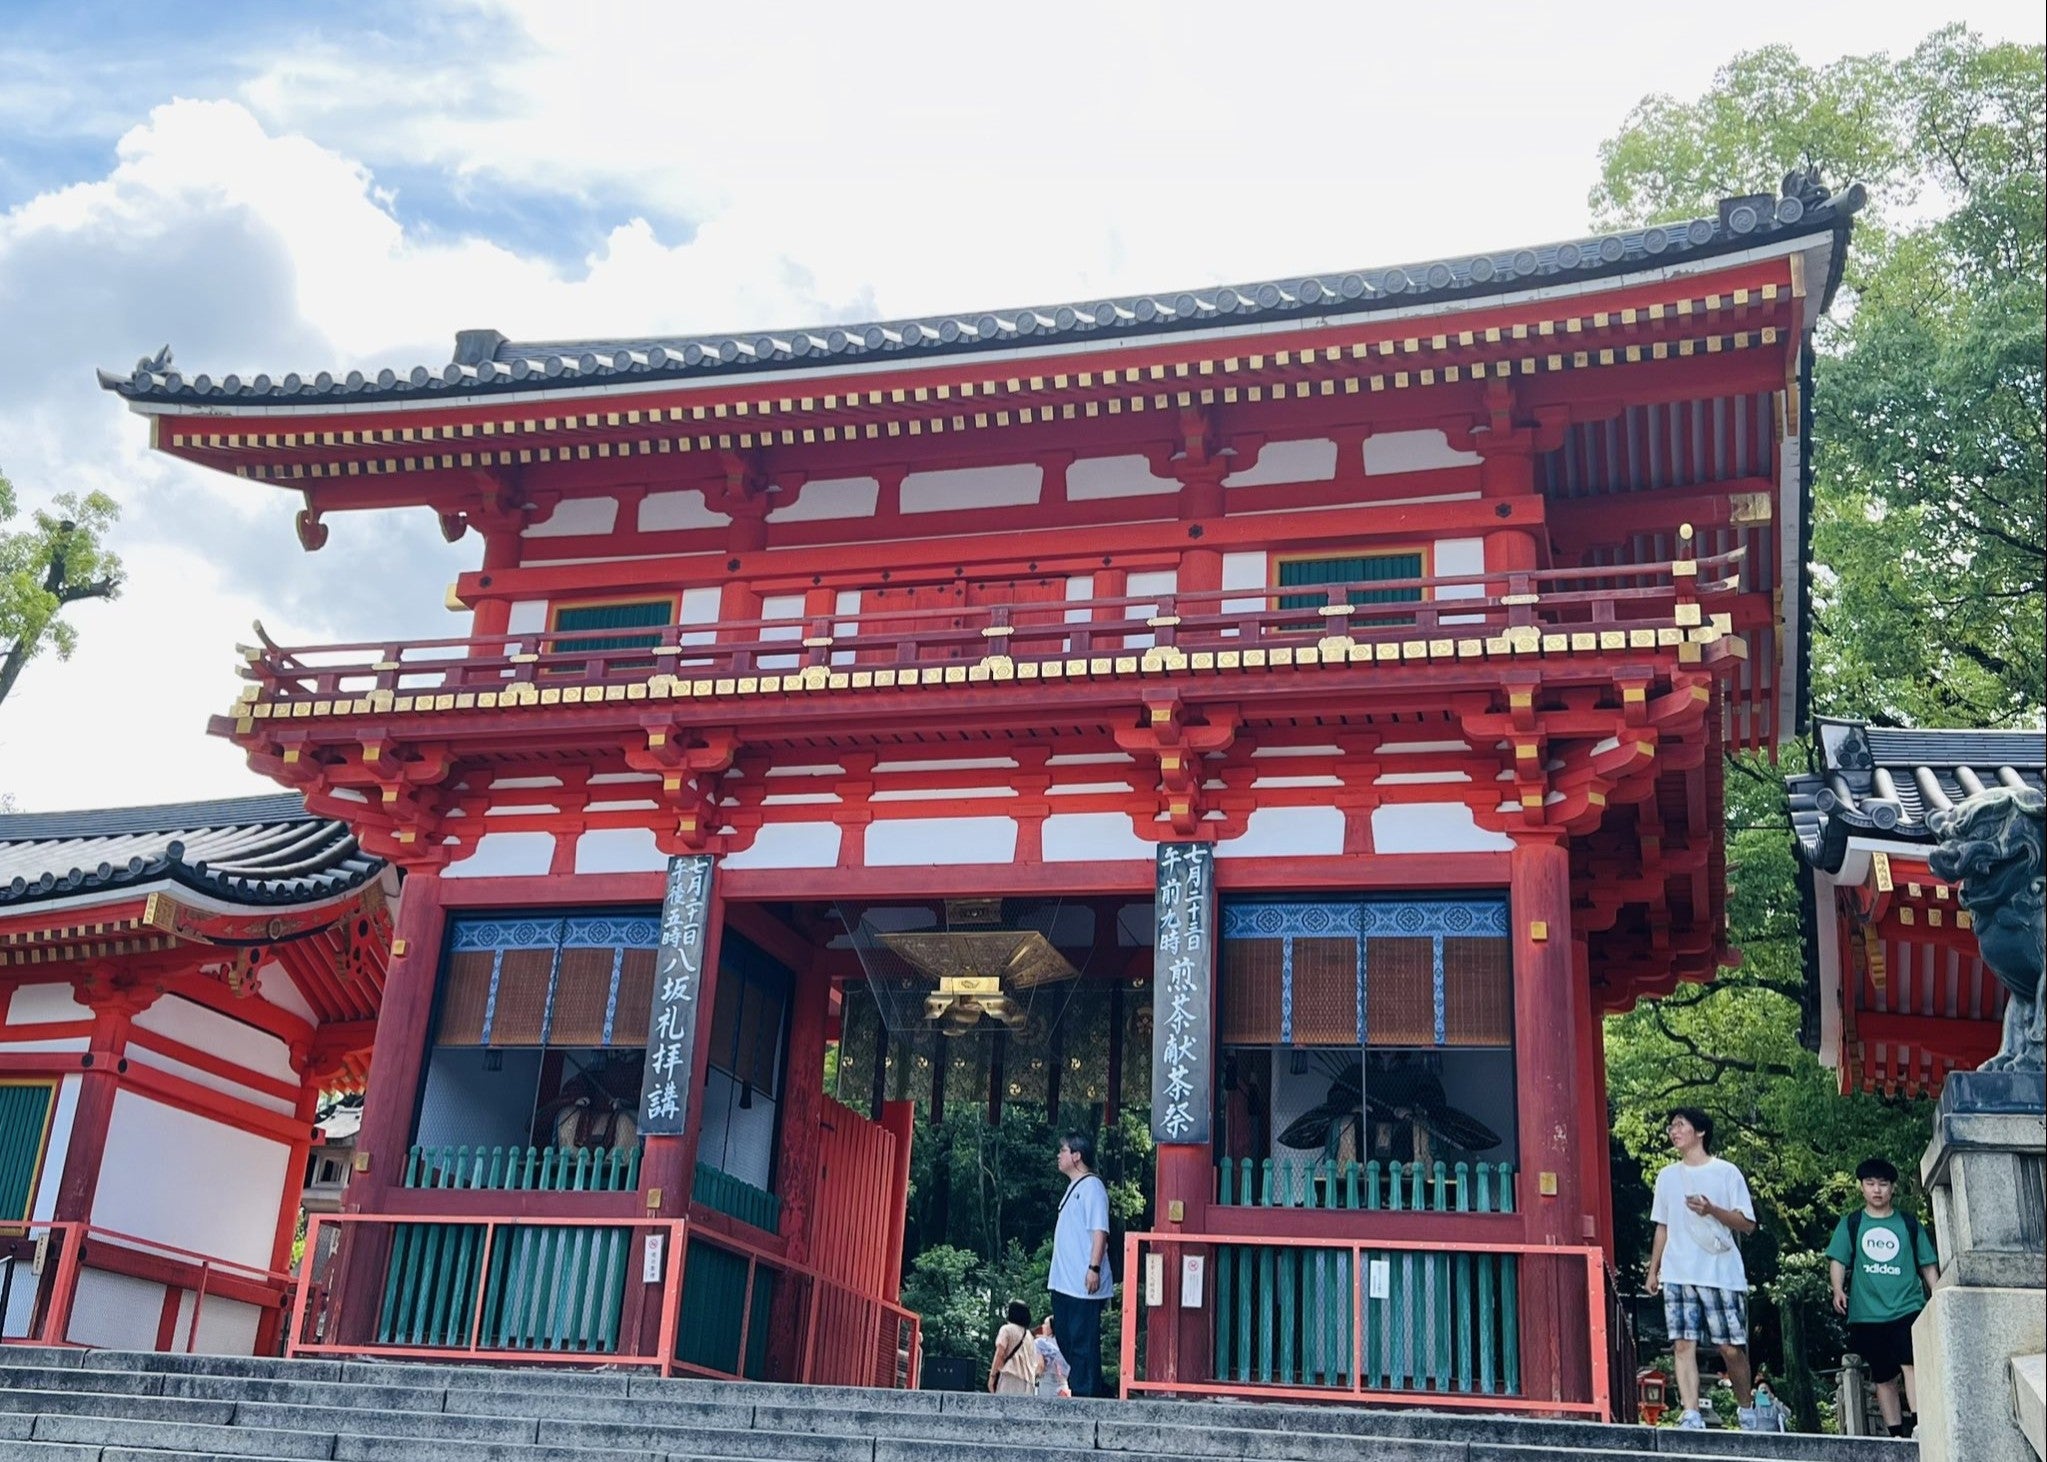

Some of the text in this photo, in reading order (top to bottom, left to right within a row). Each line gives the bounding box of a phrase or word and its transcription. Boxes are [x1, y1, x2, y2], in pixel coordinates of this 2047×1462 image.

[661, 858, 689, 948] 午後五時
[682, 858, 708, 946] 七月二十一日
[1159, 846, 1182, 956] 午前九時
[1183, 843, 1208, 951] 七月二十三日
[647, 947, 696, 1120] 八坂礼拝講
[1160, 956, 1198, 1139] 煎茶献茶祭
[1866, 1238, 1896, 1250] neo
